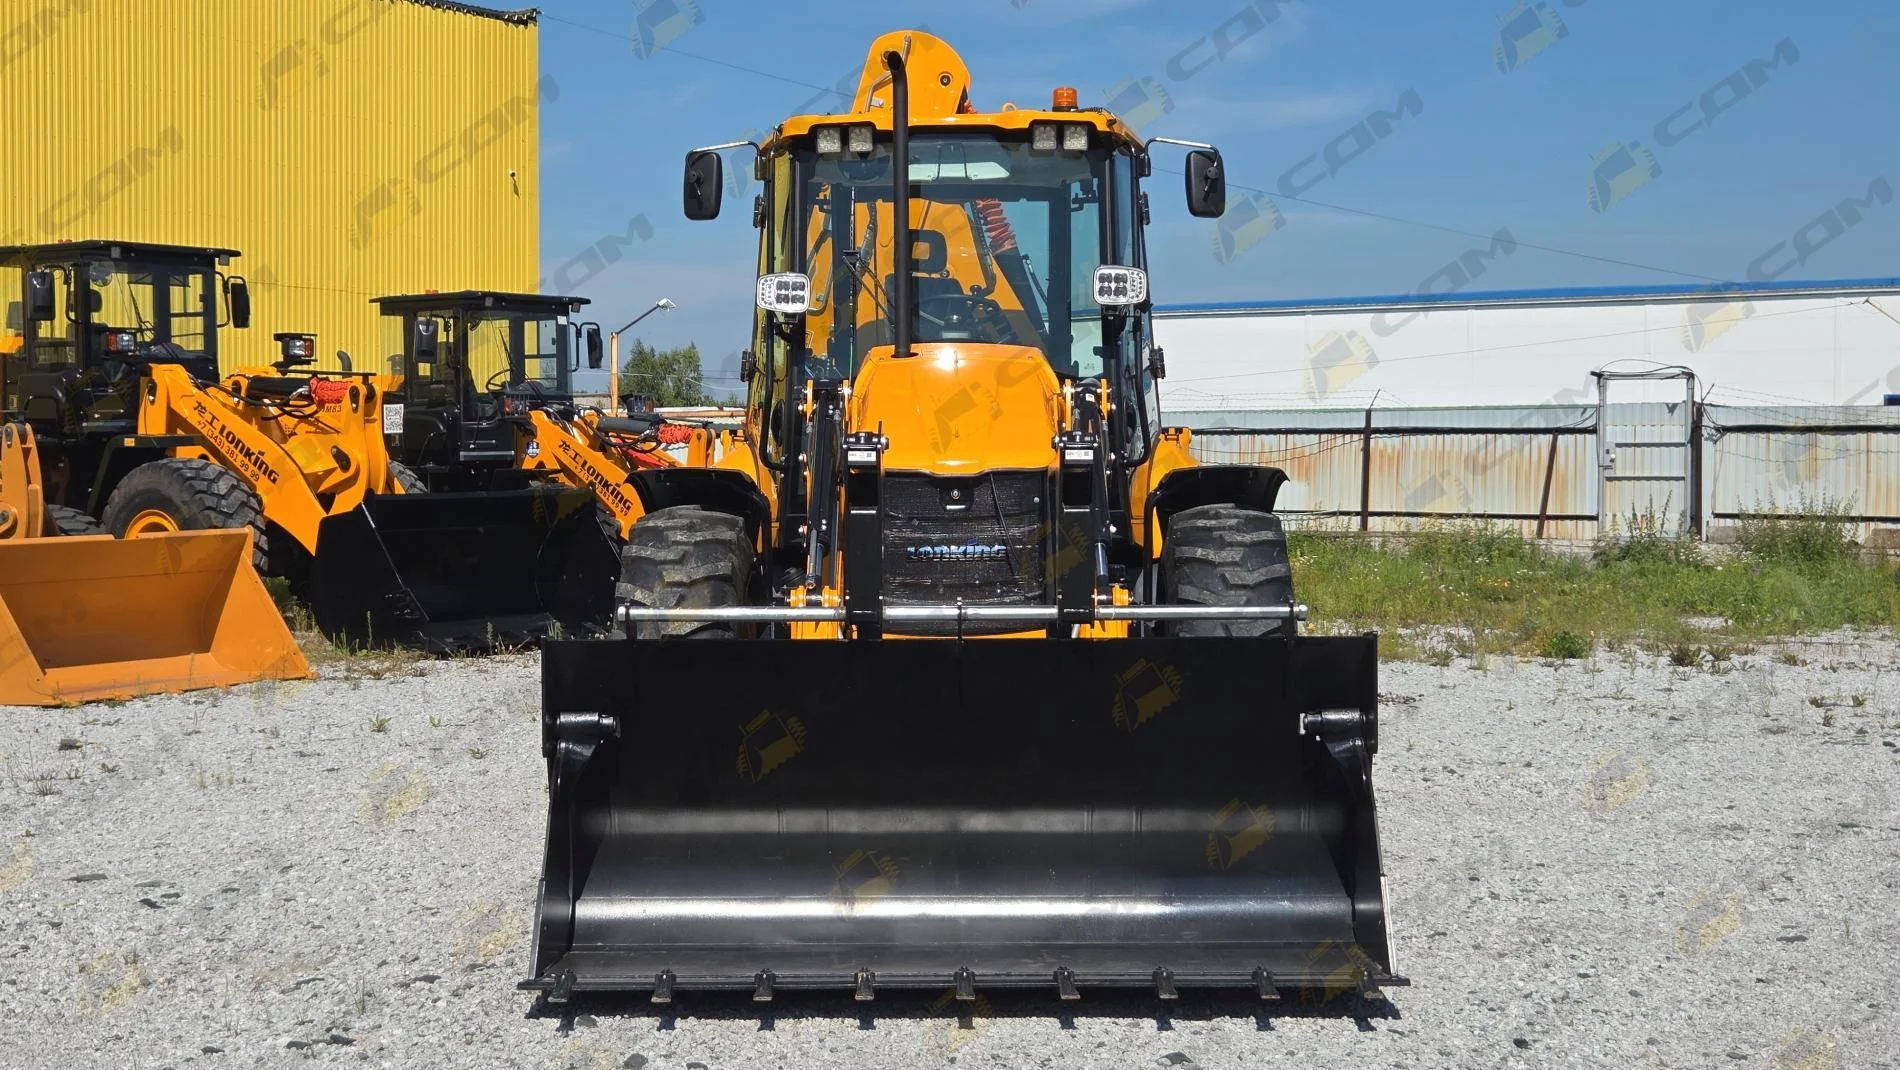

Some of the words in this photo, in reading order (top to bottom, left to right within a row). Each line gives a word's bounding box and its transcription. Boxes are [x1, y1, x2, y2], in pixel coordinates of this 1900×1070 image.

[224, 445, 239, 463] 381
[239, 459, 250, 472] 99
[249, 469, 260, 482] 99
